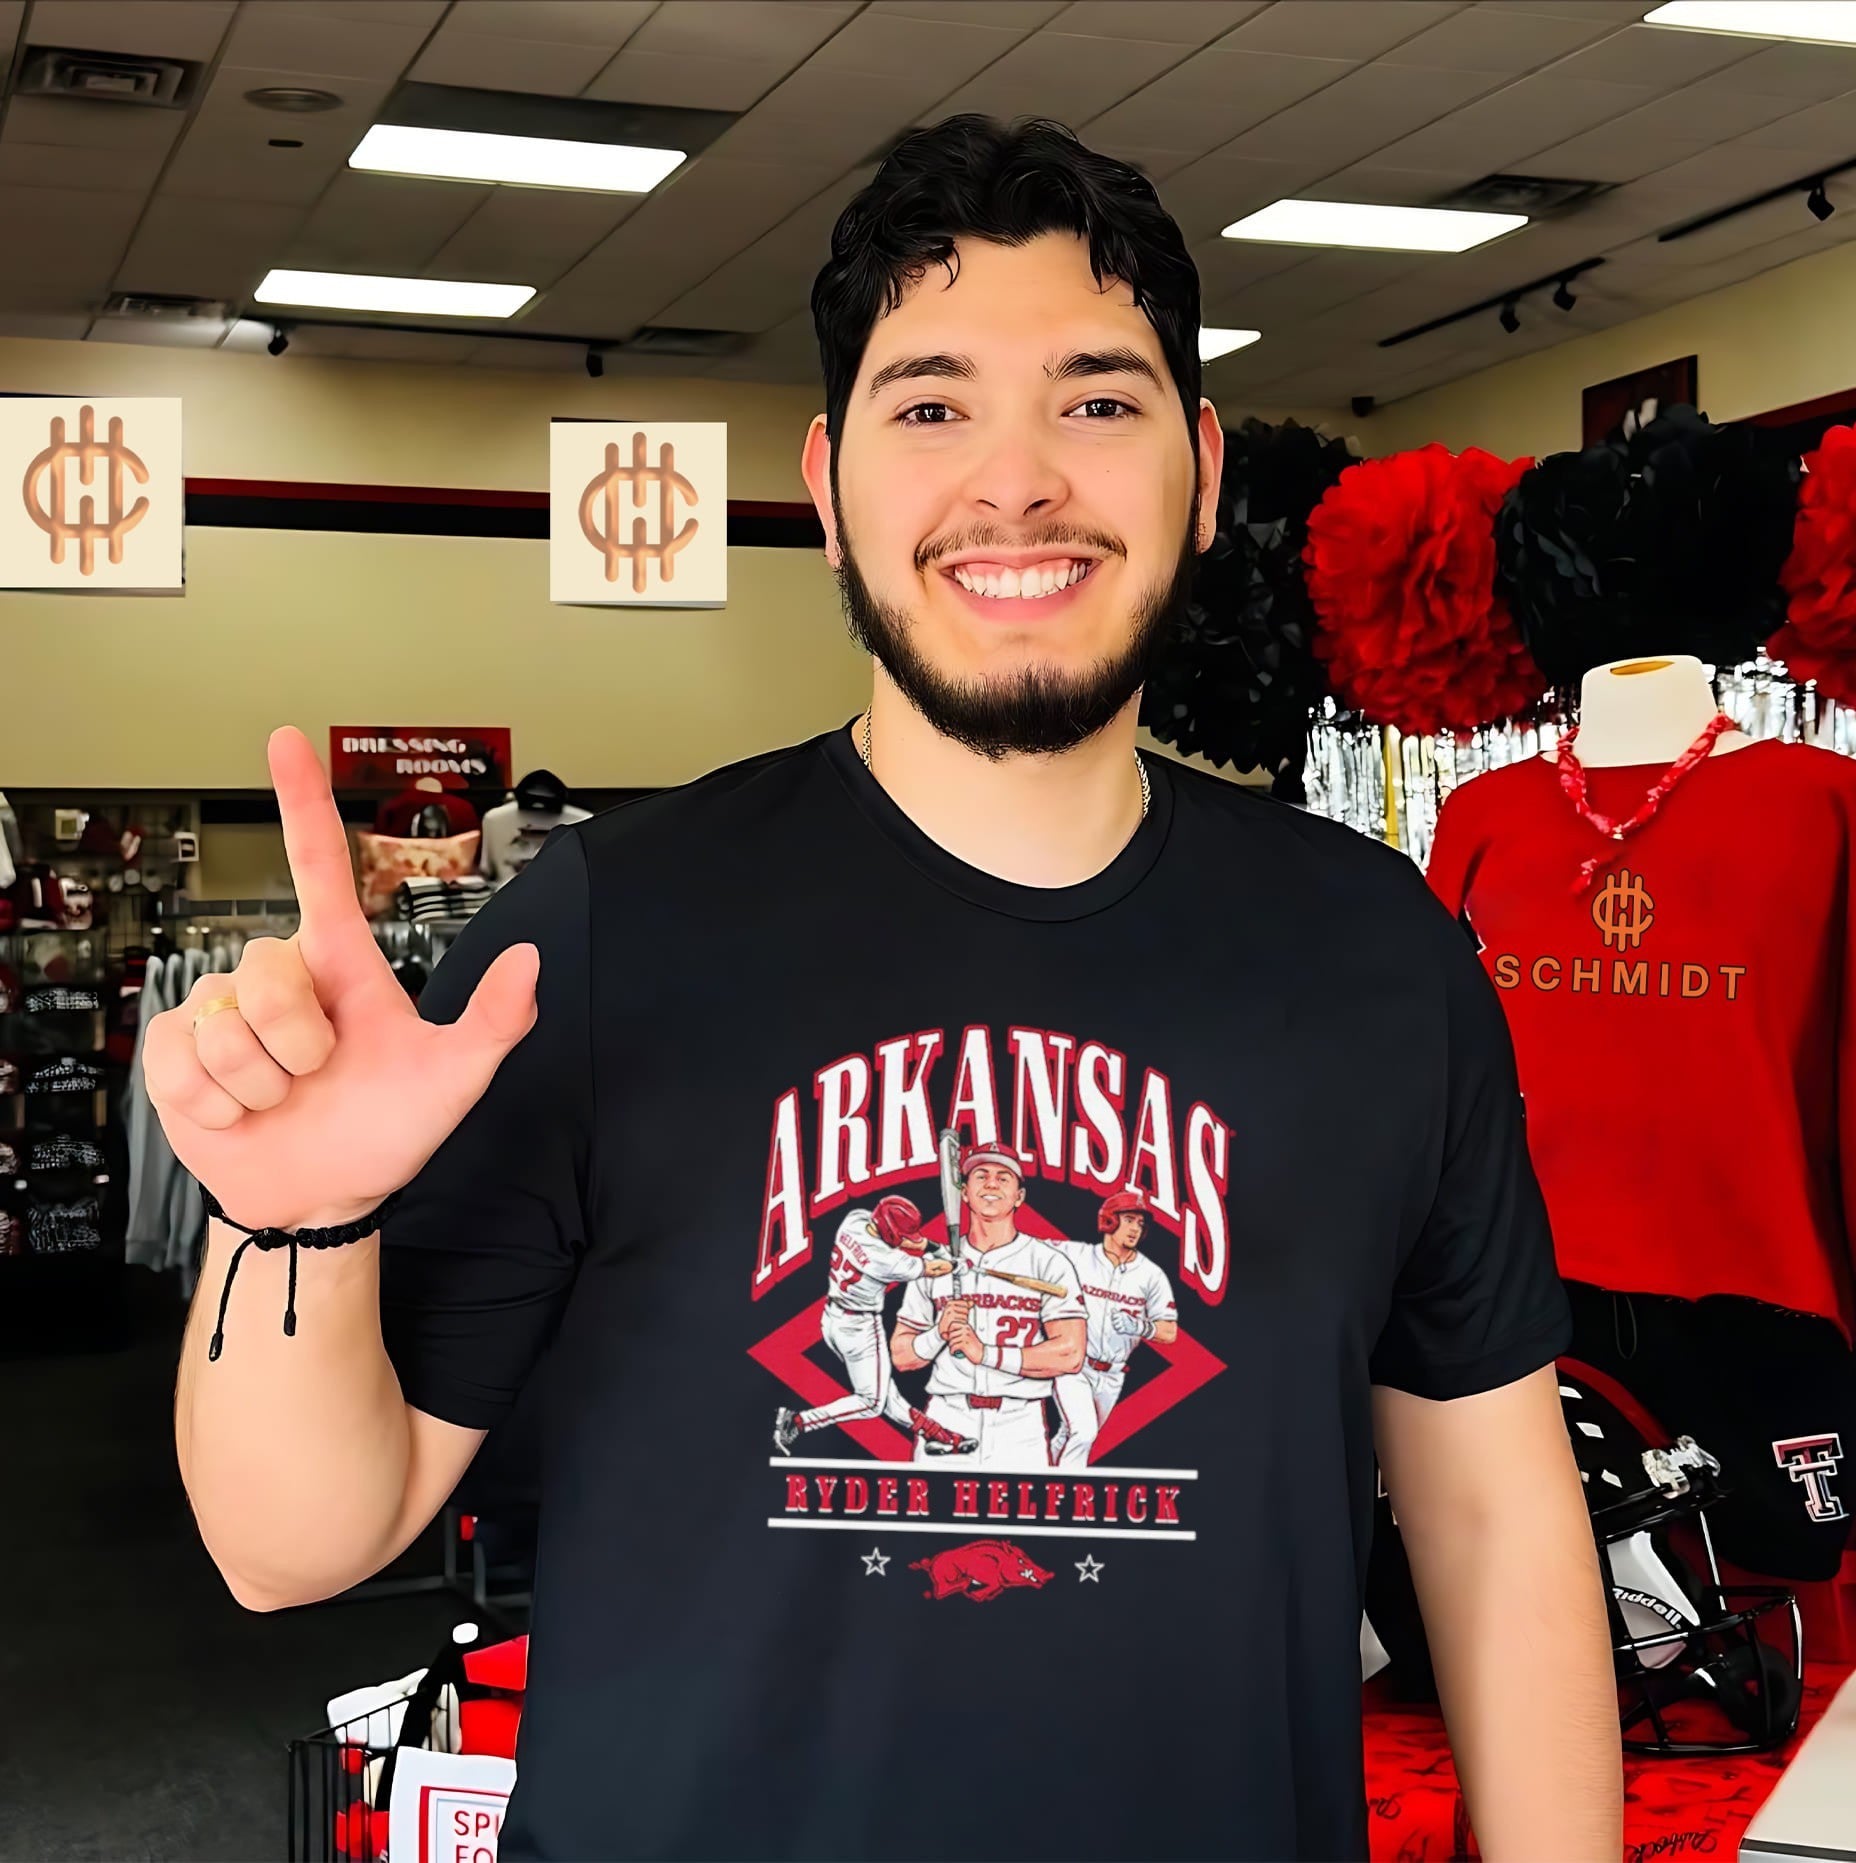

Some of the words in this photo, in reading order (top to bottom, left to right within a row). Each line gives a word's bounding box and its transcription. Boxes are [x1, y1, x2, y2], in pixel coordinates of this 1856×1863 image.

[342, 737, 467, 754] DRESSING
[396, 758, 487, 774] ROOMS
[1494, 953, 1747, 1001] SCHMIDT
[752, 1024, 1230, 1306] ARKANSAS
[996, 1316, 1040, 1348] 27
[785, 1474, 930, 1516] RYDER
[953, 1480, 1180, 1524] HELFRICK
